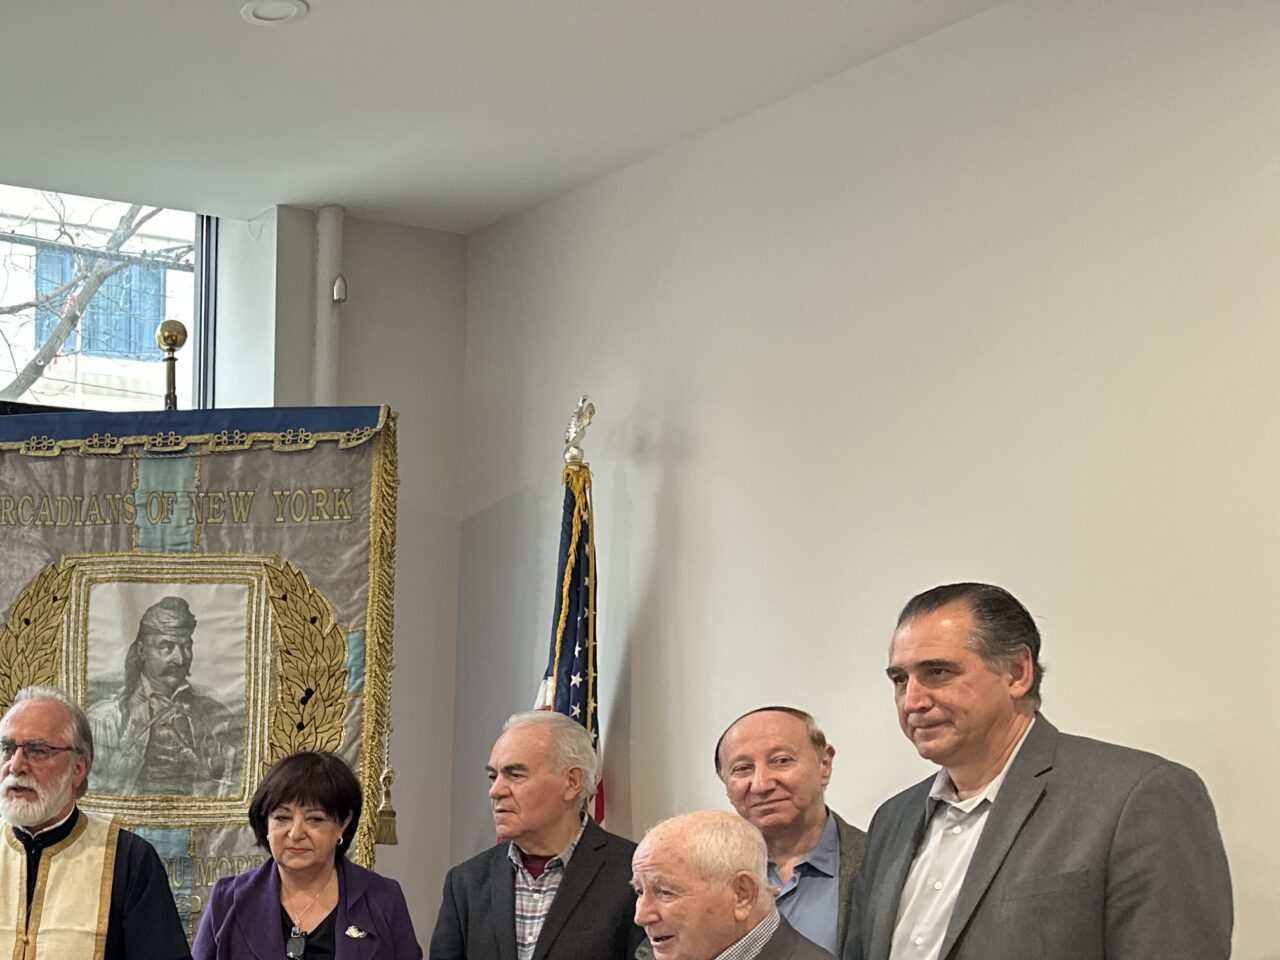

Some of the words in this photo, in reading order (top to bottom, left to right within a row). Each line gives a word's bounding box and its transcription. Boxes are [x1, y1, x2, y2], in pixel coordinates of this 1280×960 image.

[146, 493, 178, 525] OF
[187, 490, 255, 524] NEW
[272, 488, 353, 522] YORK
